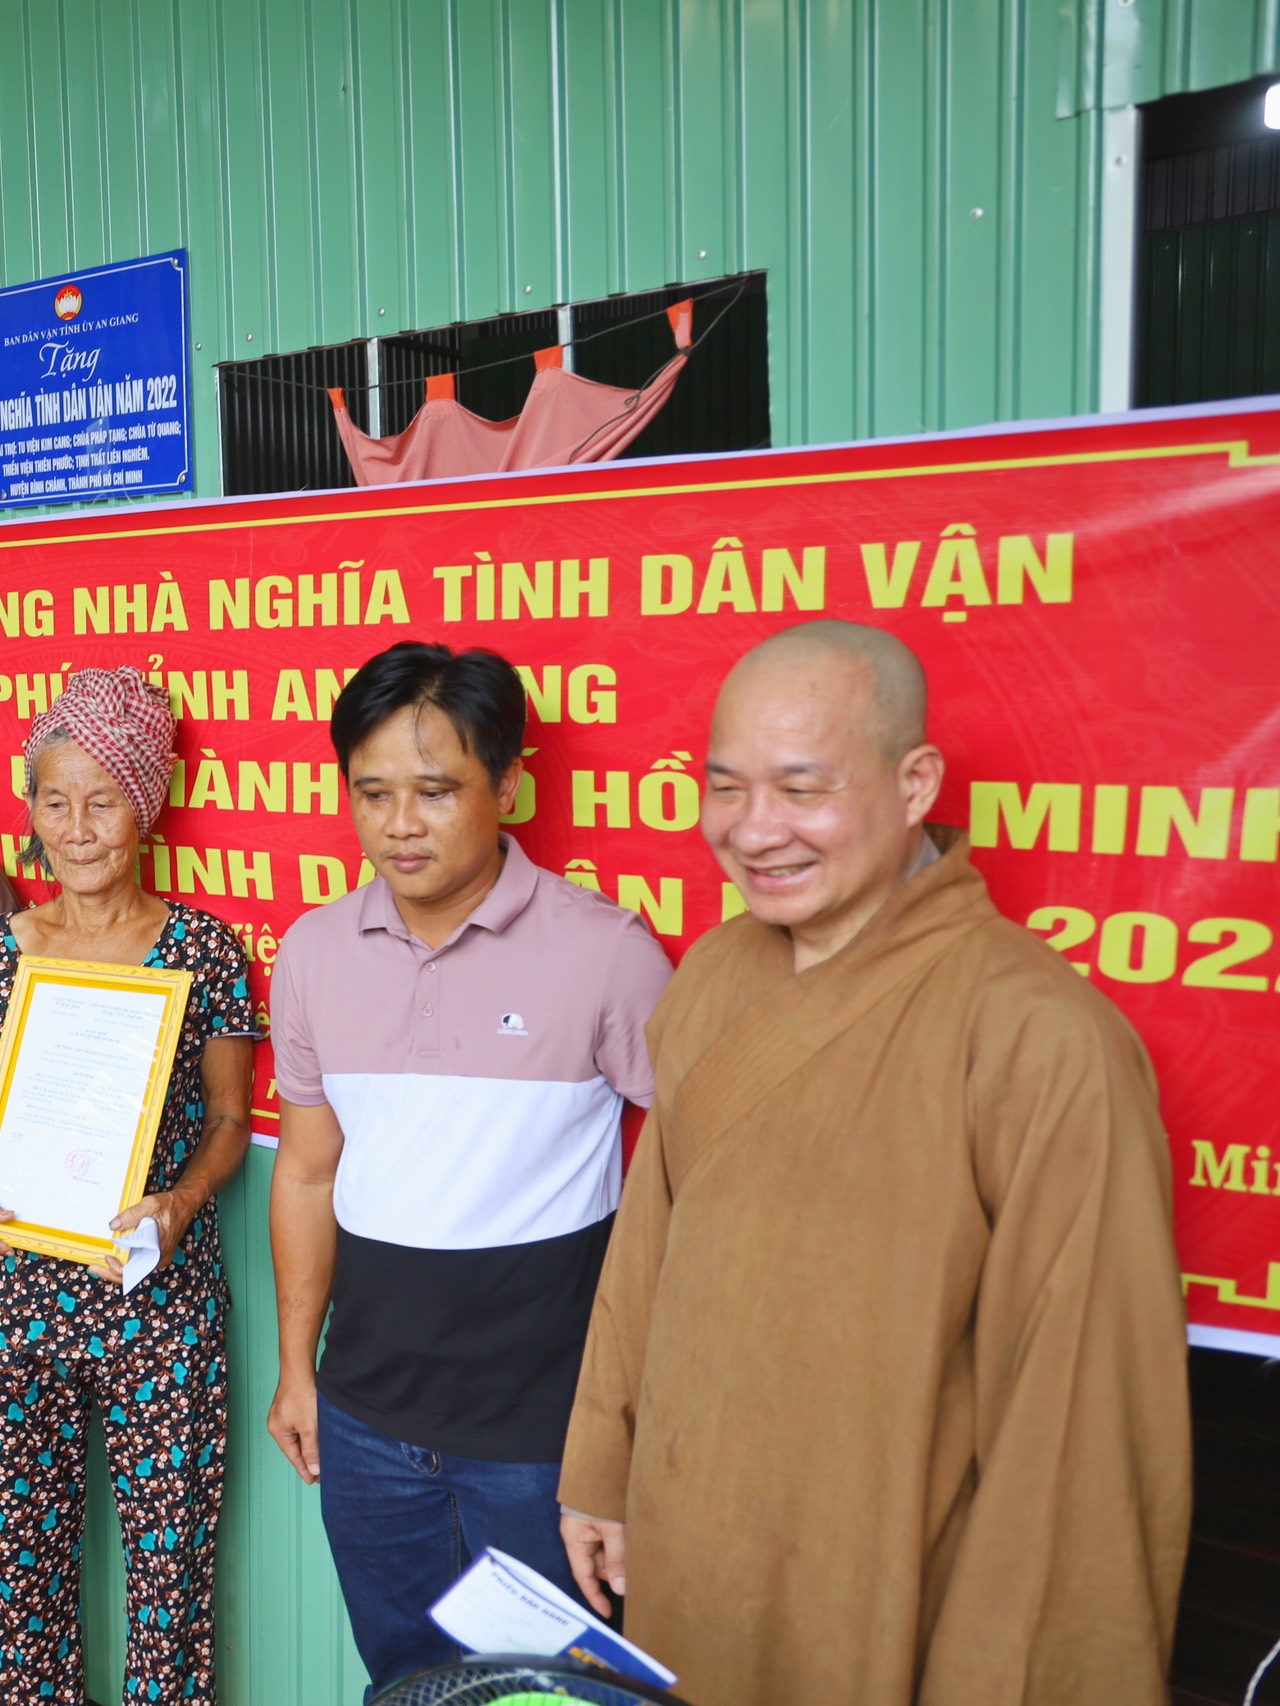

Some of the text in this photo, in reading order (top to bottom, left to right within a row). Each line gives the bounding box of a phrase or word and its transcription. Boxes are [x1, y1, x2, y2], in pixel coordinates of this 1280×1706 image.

[4, 335, 20, 347] BAN
[22, 330, 39, 344] DÂN
[40, 327, 58, 341] VẬN
[59, 323, 80, 337] TỈNH
[95, 318, 108, 330] AN
[109, 312, 139, 327] GIANG
[39, 340, 101, 382] Tặng
[0, 390, 33, 432] NGHĨA
[35, 387, 60, 426] TÌNH
[62, 382, 87, 423] DÂN
[89, 377, 113, 425] VẬN
[115, 373, 144, 415] NĂM
[146, 374, 177, 411] 2022
[17, 441, 25, 454] TU
[26, 437, 40, 455] VIỆN
[40, 437, 52, 451] KIM
[53, 435, 72, 449] CANG;
[90, 427, 107, 445] PHÁP
[108, 427, 127, 445] TẠNG;
[156, 420, 181, 438] QUANG;
[20, 459, 34, 477] VIỆN
[106, 448, 121, 465] LIÊN
[10, 480, 29, 498] HUYỆN
[29, 478, 44, 495] BÌNH
[45, 476, 67, 493] CHÁNH,
[68, 474, 88, 491] THÀNH
[89, 470, 102, 489] PHỐ
[113, 468, 124, 486] CHÍ
[125, 469, 143, 484] MINH
[73, 571, 188, 634] NHÀ
[209, 560, 410, 630] NGHĨA
[433, 552, 609, 622] TÌNH
[641, 537, 826, 615] DÂN
[861, 523, 1074, 622] VẬN
[142, 654, 250, 720] NH
[271, 669, 358, 720] AN
[170, 749, 338, 815] ÀNH
[572, 751, 700, 831] HỒ
[1027, 906, 1280, 993] 202
